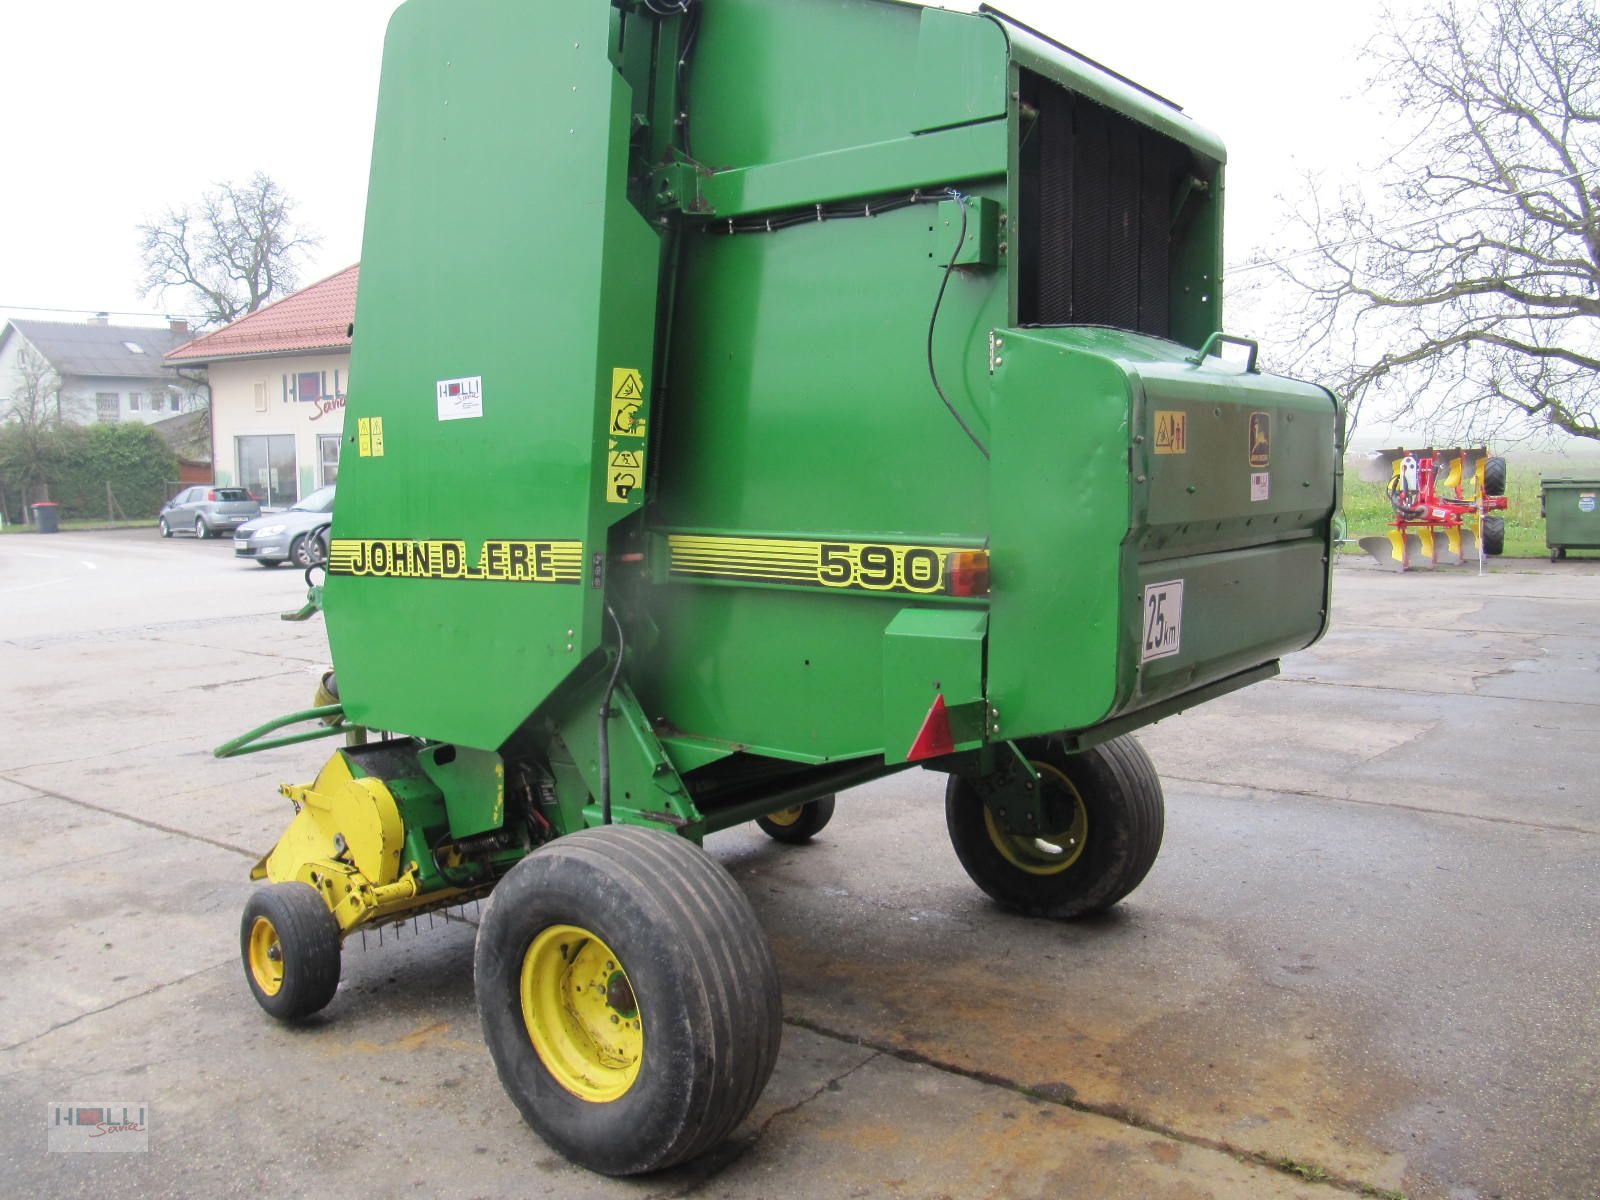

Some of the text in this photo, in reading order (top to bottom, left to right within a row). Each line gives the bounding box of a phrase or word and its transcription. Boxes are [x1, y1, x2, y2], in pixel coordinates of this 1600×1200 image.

[282, 369, 347, 403] HOLL
[439, 379, 479, 398] HOLLI
[352, 541, 430, 575] JOHN
[441, 542, 552, 579] DERE
[818, 543, 940, 590] 590
[1145, 592, 1176, 651] 25 km
